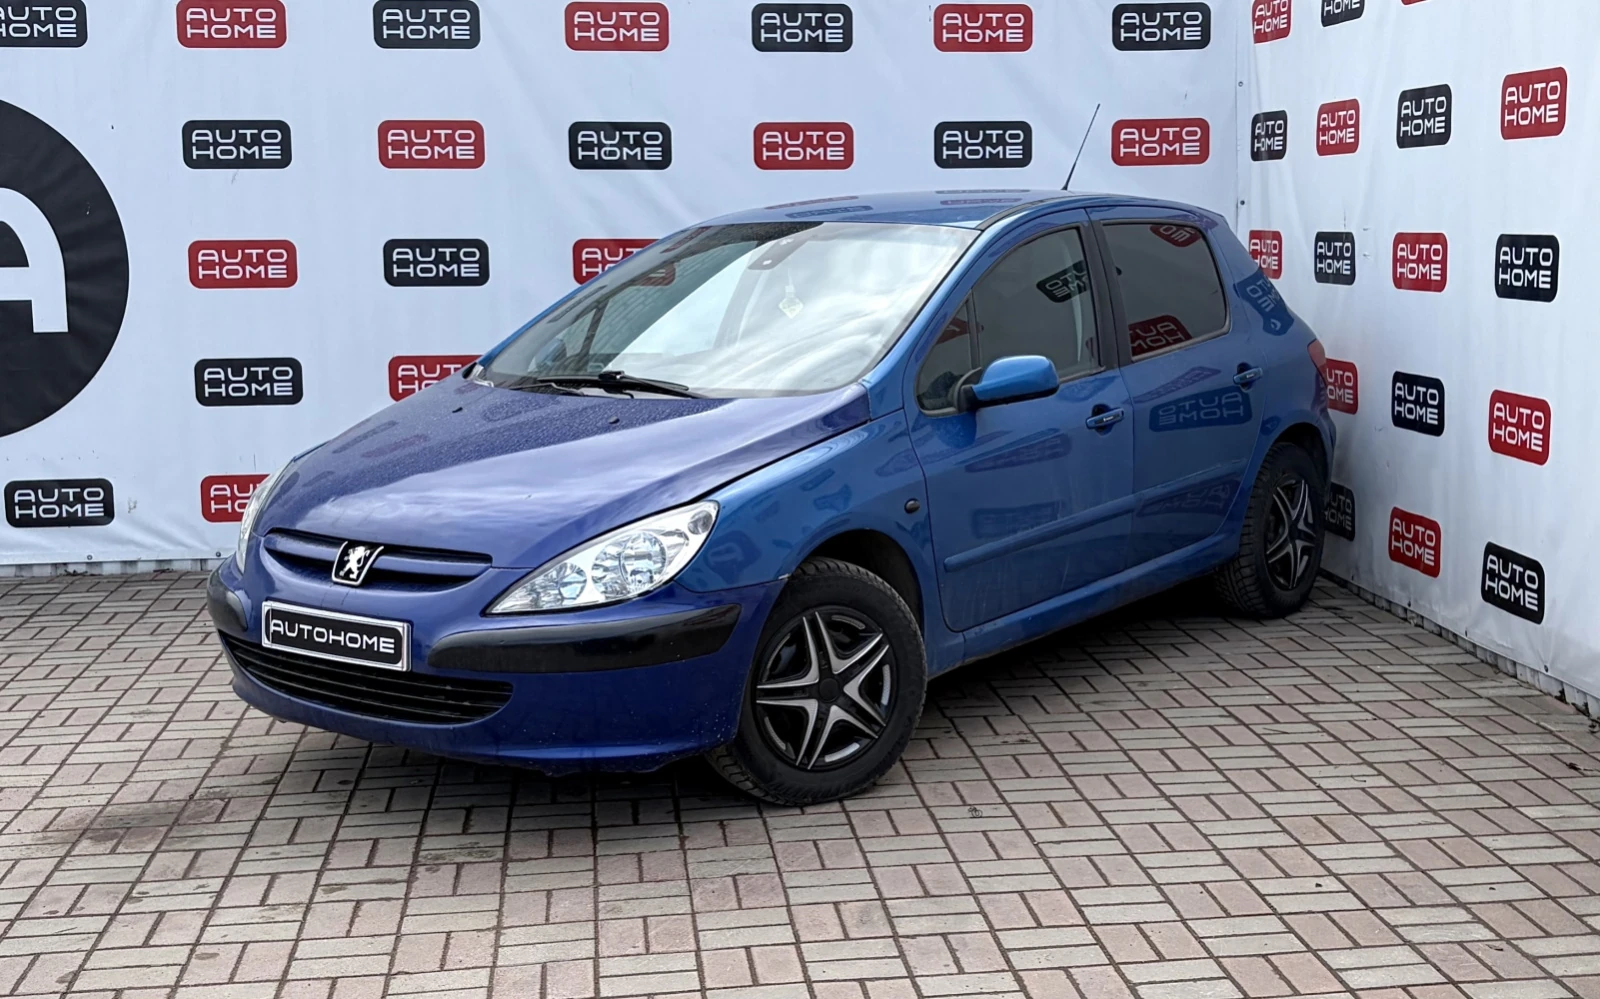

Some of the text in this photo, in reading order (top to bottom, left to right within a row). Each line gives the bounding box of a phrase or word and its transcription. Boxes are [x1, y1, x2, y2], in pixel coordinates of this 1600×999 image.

[186, 8, 276, 22] AUTO
[383, 9, 470, 22] AUTO
[1255, 0, 1288, 18] AUTO
[574, 12, 660, 25] AUTO
[761, 13, 844, 26] AUTO
[943, 13, 1024, 26] AUTO
[1121, 12, 1202, 25] AUTO
[1254, 14, 1287, 34] HOME
[187, 25, 276, 38] HOME
[383, 26, 470, 39] HOME
[574, 28, 659, 41] HOME
[761, 29, 843, 42] HOME
[943, 29, 1023, 42] HOME
[1121, 27, 1201, 41] HOME
[1506, 81, 1560, 105] AUTO
[1401, 97, 1446, 117] AUTO
[1320, 110, 1355, 128] AUTO
[1505, 104, 1558, 126] HOME
[1400, 117, 1445, 136] HOME
[192, 130, 281, 143] AUTO
[388, 130, 475, 143] AUTO
[578, 131, 662, 144] AUTO
[763, 132, 845, 144] AUTO
[943, 130, 1024, 143] AUTO
[1120, 127, 1201, 141] AUTO
[1319, 128, 1354, 145] HOME
[1120, 143, 1200, 156] HOME
[1254, 136, 1283, 152] HOME
[192, 146, 281, 159] HOME
[388, 146, 474, 159] HOME
[578, 147, 662, 160] HOME
[763, 148, 844, 160] HOME
[943, 146, 1022, 159] HOME
[1250, 239, 1278, 253] AUTO
[1317, 242, 1351, 256] AUTO
[1398, 244, 1442, 260] AUTO
[198, 250, 287, 262] AUTO
[393, 248, 480, 261] AUTO
[1500, 247, 1552, 266] AUTO
[199, 265, 287, 279] HOME
[394, 264, 479, 277] HOME
[1317, 259, 1350, 274] HOME
[1397, 263, 1441, 280] HOME
[1499, 268, 1551, 288] HOME
[204, 367, 292, 381] AUTO
[398, 364, 462, 378] AUT
[1326, 368, 1353, 386] UTO
[205, 383, 292, 397] HOME
[1327, 385, 1353, 404] OME
[1395, 382, 1438, 405] AUTO
[1395, 401, 1438, 424] HOME
[1494, 403, 1544, 429] AUTO
[1493, 423, 1542, 452] HOME
[14, 488, 104, 502] AUTO
[210, 484, 261, 497] AU
[1331, 492, 1352, 513] UTO
[15, 504, 104, 518] HOME
[1393, 518, 1435, 546] AUTO
[1392, 536, 1434, 566] HOME
[1487, 555, 1538, 589] AUTO
[1486, 574, 1538, 611] HOME
[271, 619, 394, 653] AUTOHOME
